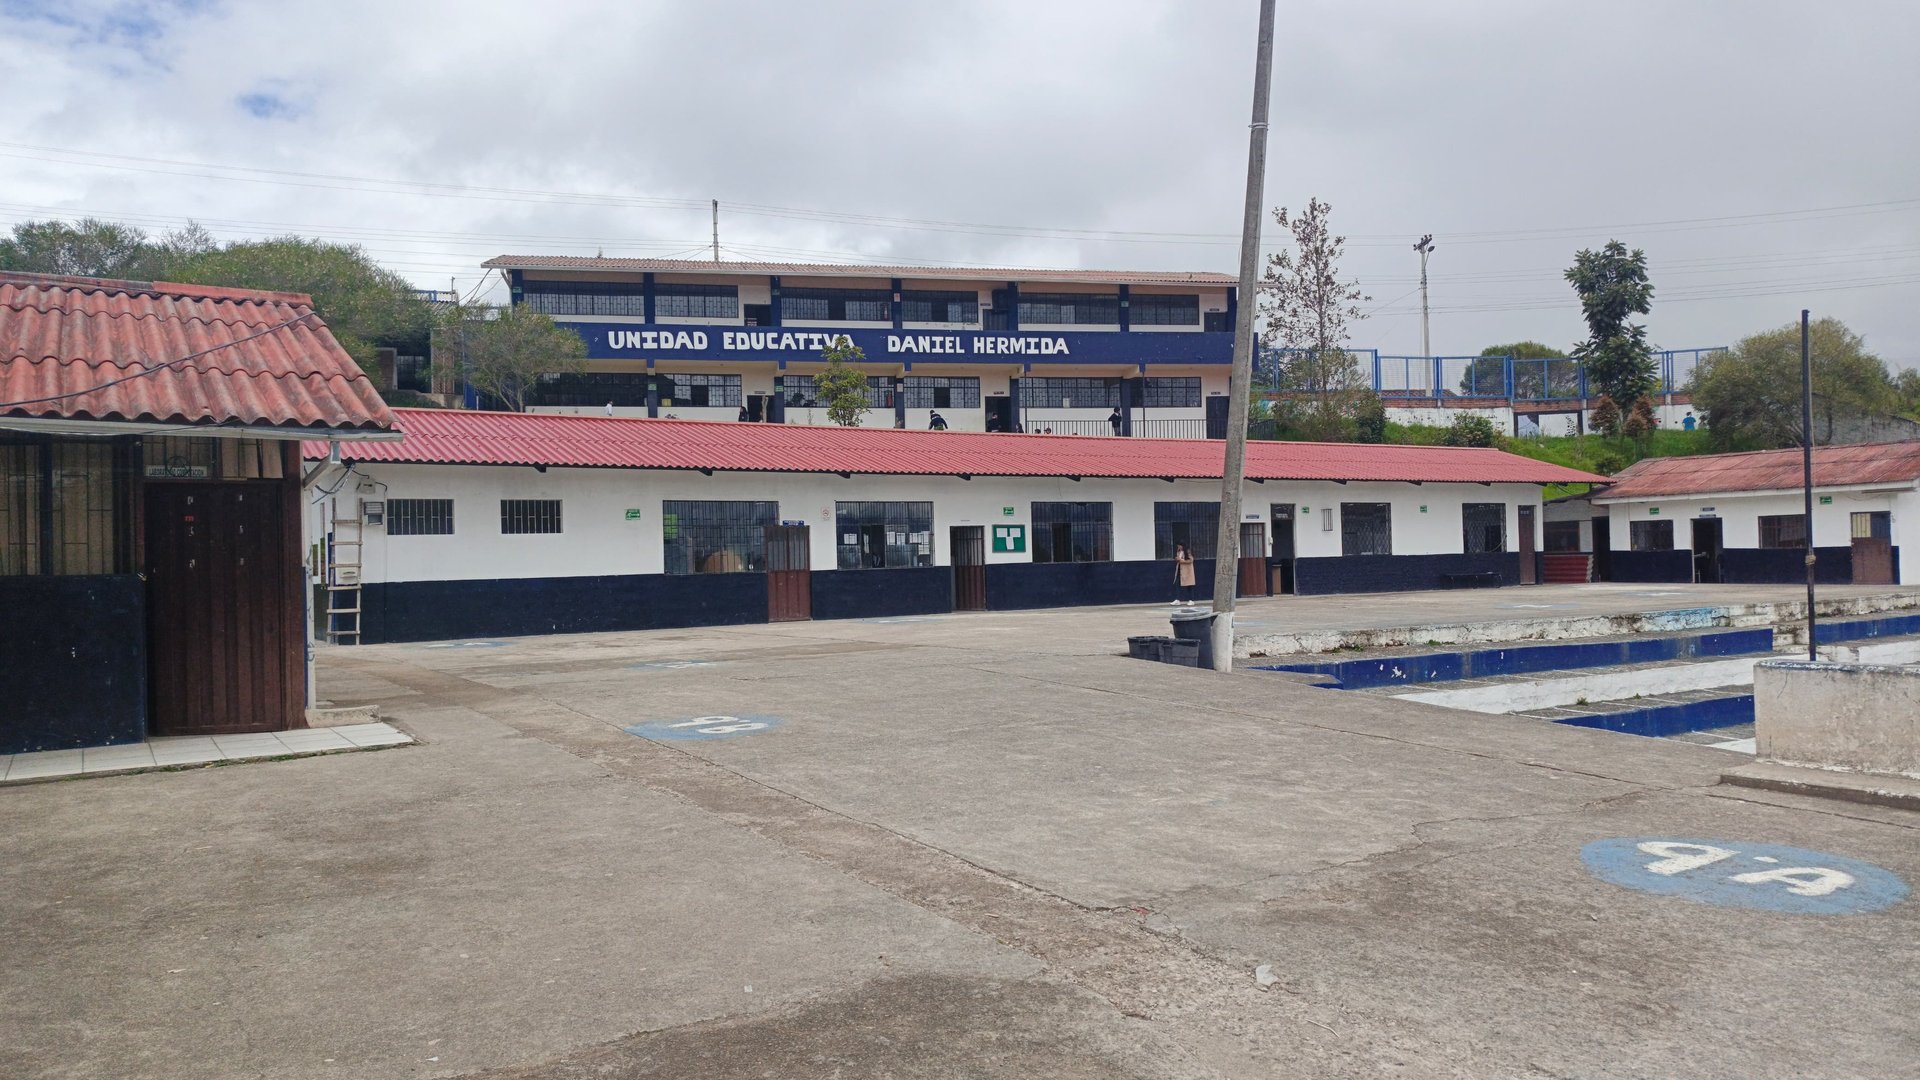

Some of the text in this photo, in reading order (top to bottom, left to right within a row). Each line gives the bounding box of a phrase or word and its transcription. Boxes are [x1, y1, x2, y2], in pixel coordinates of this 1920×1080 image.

[608, 331, 1070, 355] UNIDAD EDUCATIVA DANIEL HERMIDA
